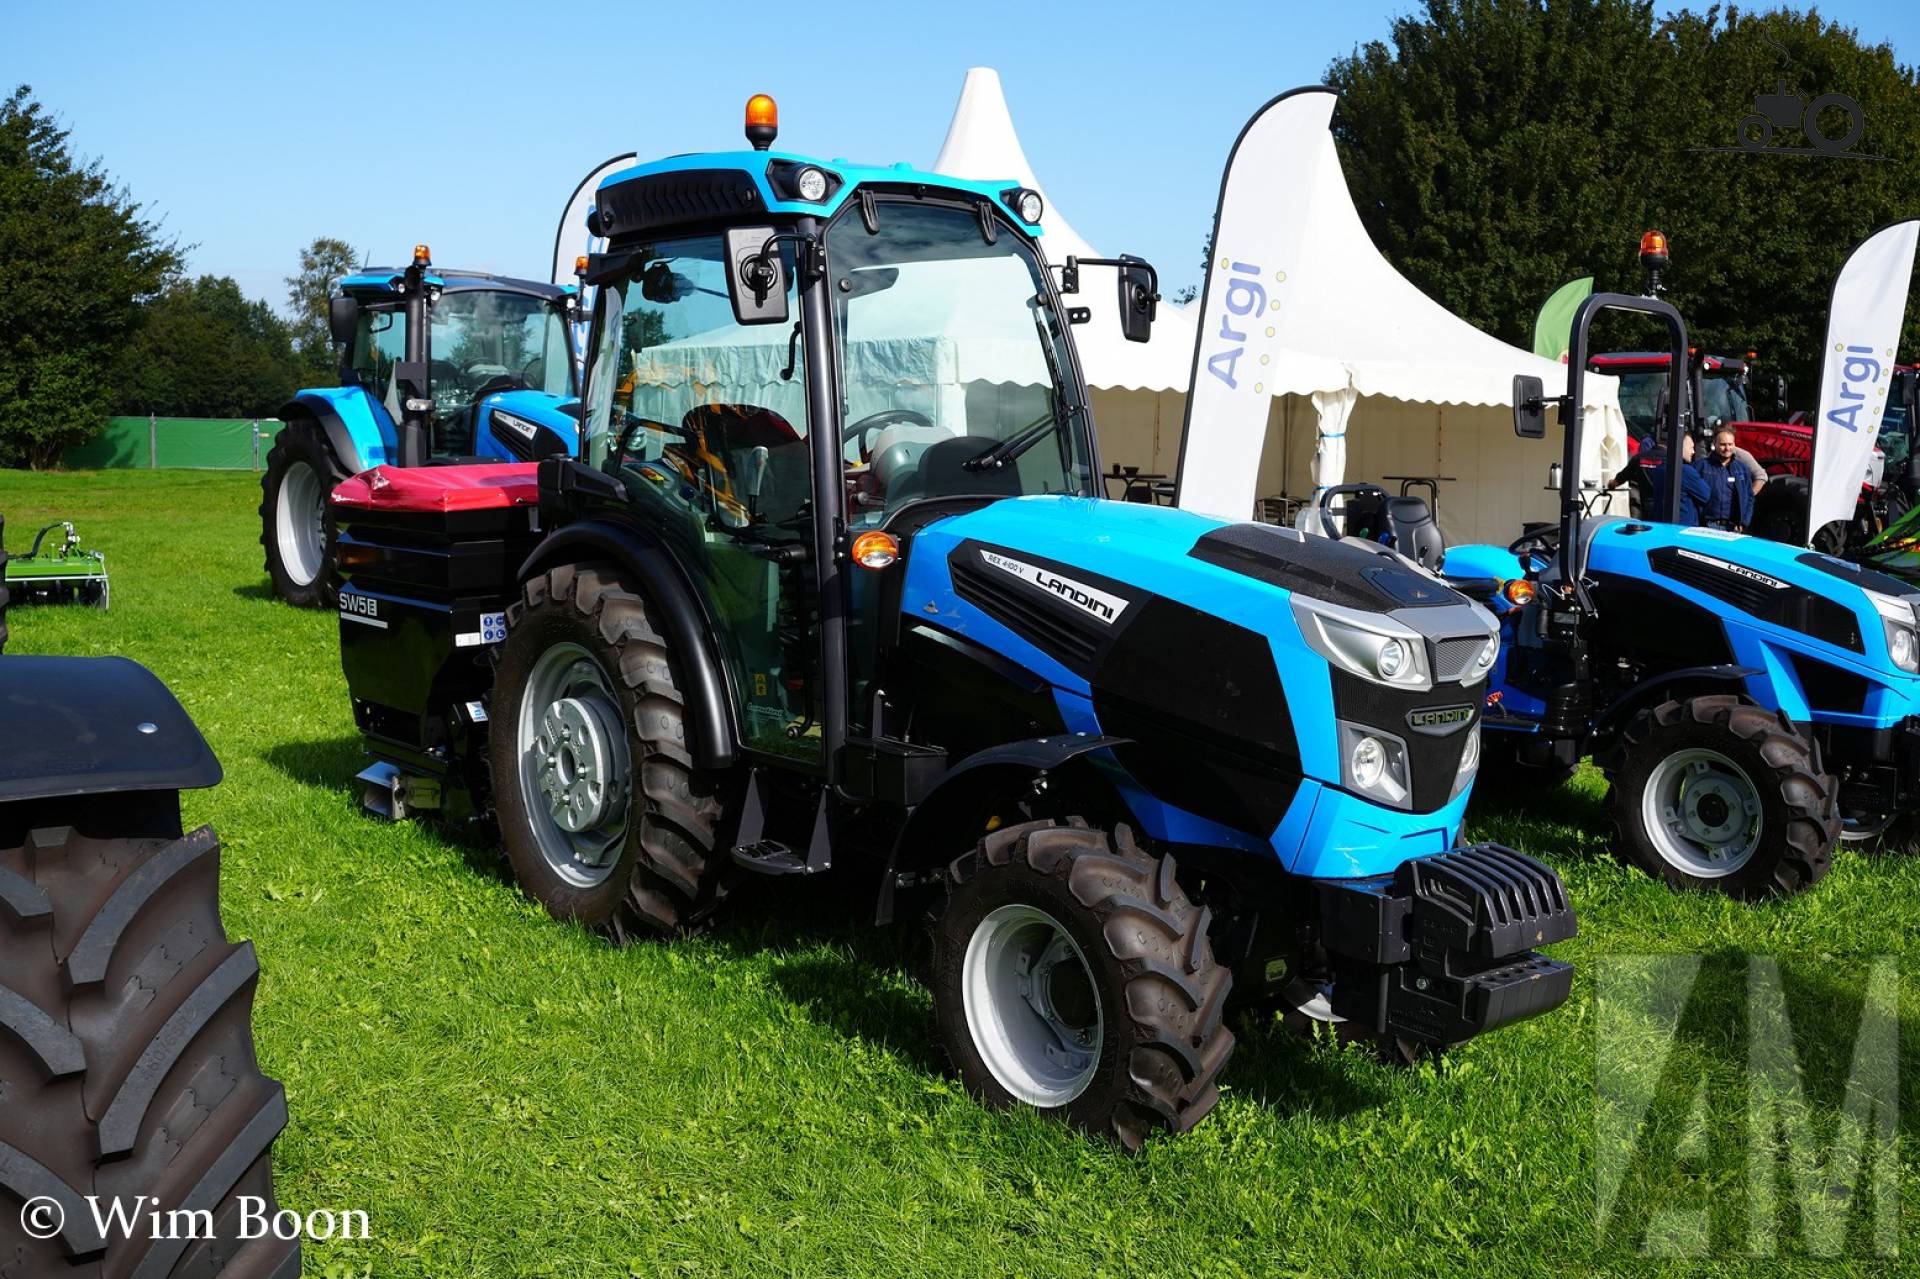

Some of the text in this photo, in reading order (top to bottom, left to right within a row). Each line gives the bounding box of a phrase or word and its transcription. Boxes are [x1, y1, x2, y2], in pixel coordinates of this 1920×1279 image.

[1207, 261, 1267, 390] Argi
[1826, 345, 1881, 433] Argi
[1035, 571, 1115, 620] LANDINI
